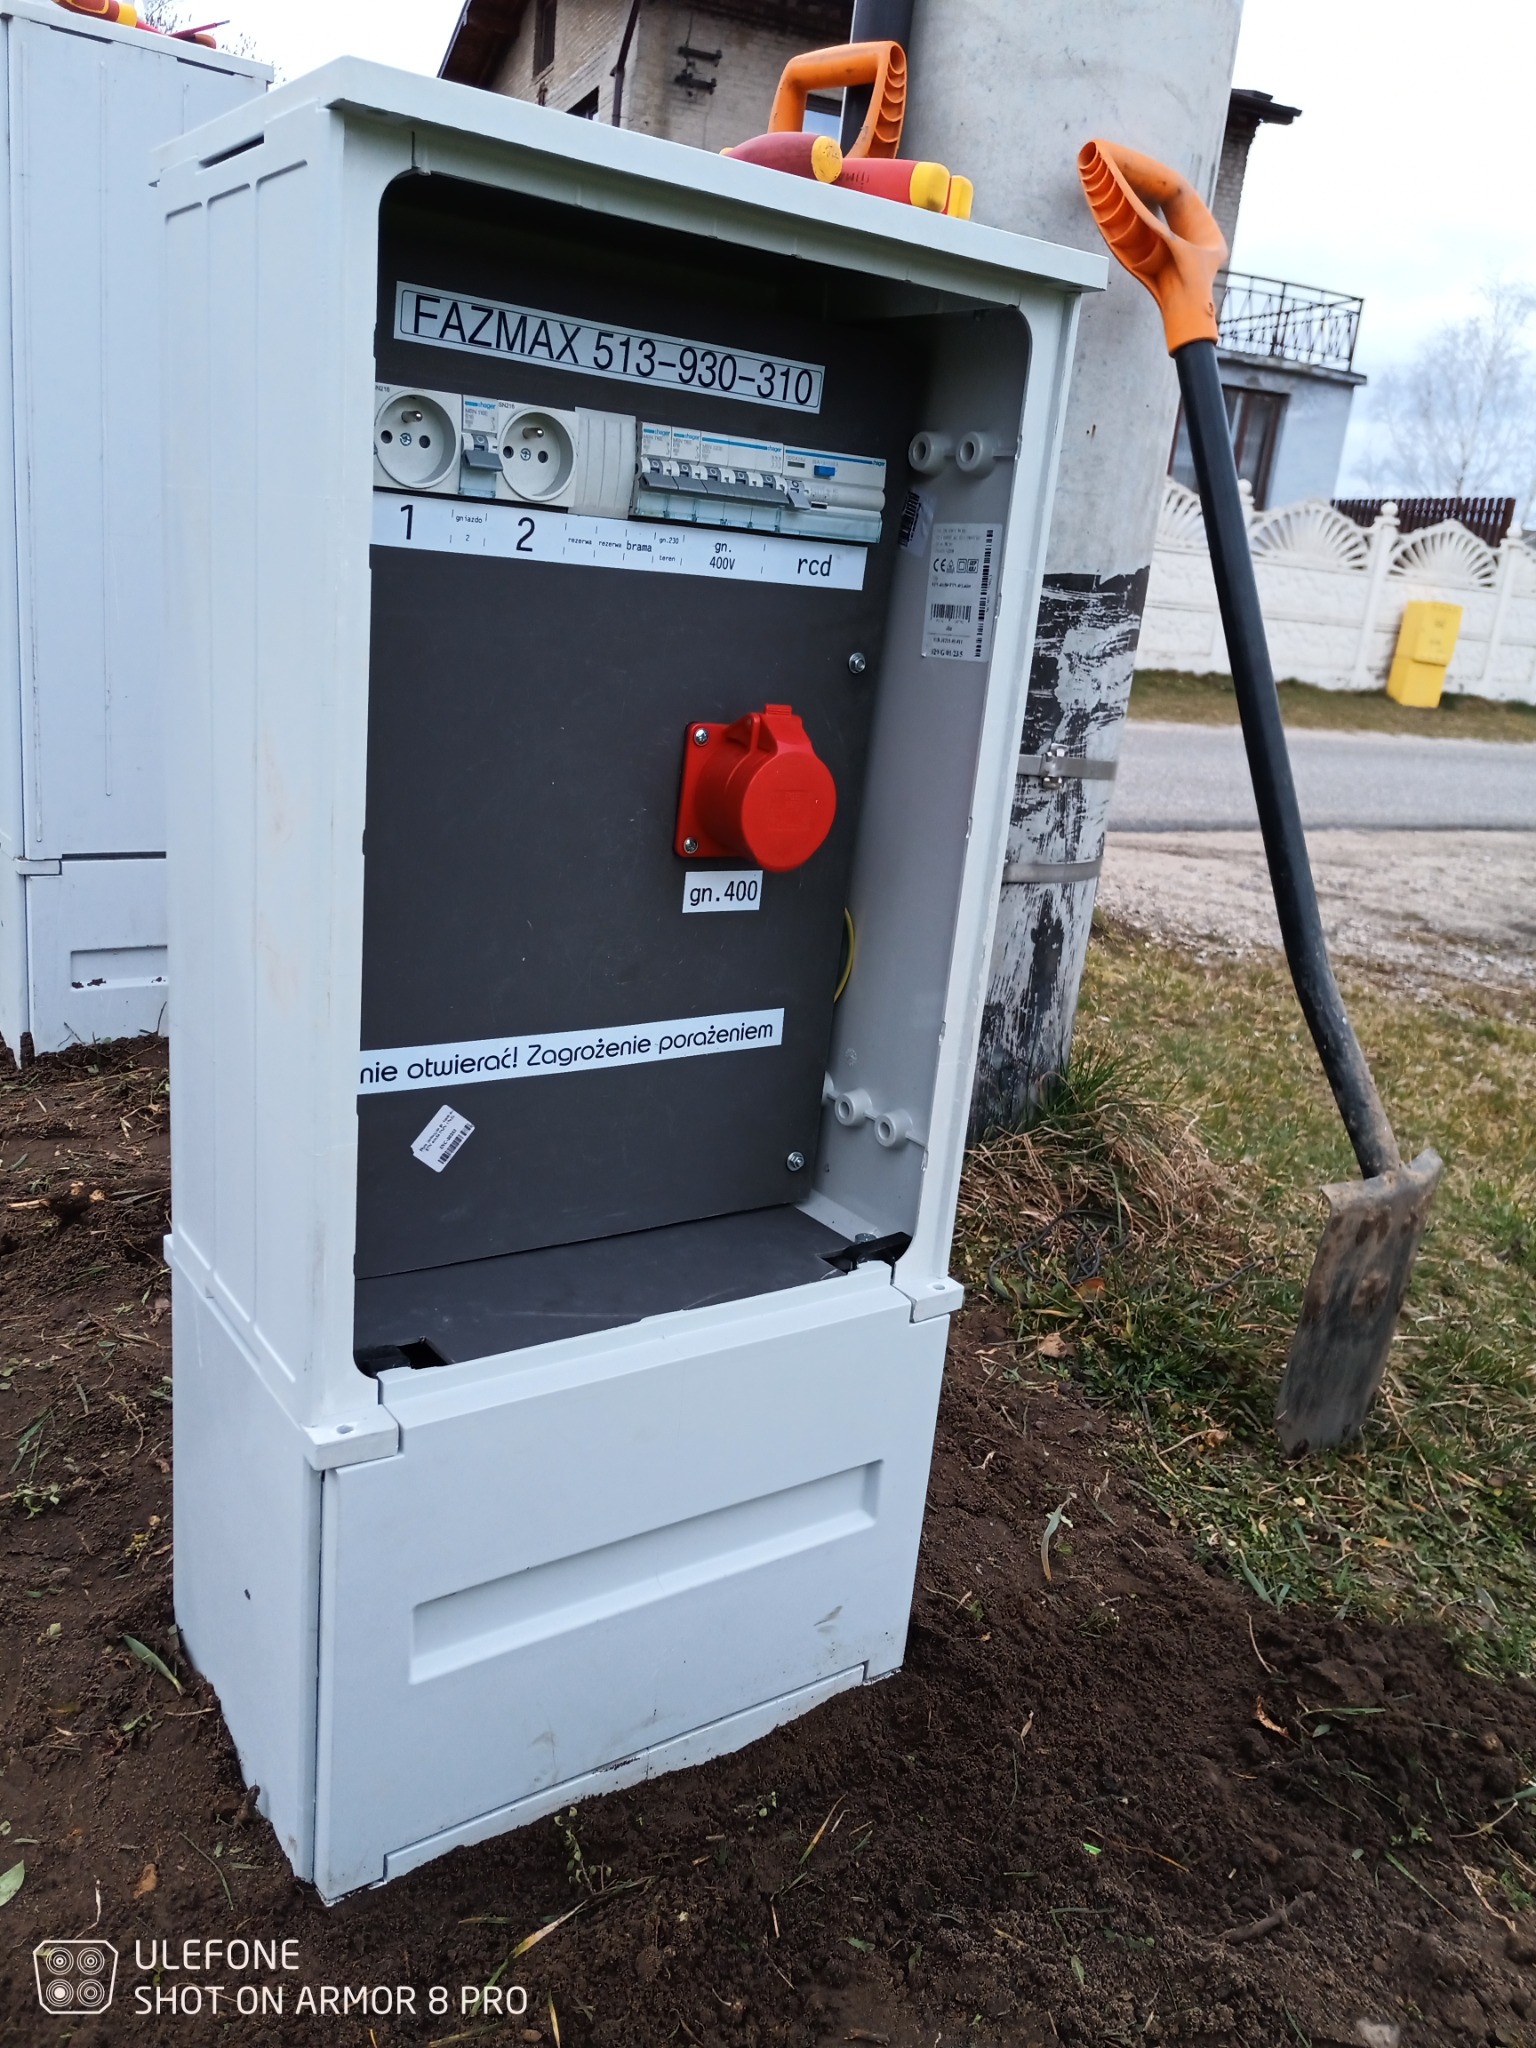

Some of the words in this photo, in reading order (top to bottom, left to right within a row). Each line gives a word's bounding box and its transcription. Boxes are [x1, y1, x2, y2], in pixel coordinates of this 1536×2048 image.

[413, 294, 582, 364] FAZMAX
[593, 331, 813, 405] 513-930-310
[400, 504, 413, 540] 1
[456, 515, 483, 524] gniazdo
[465, 534, 470, 542] 2
[516, 517, 536, 552] 2
[568, 537, 593, 546] rezerwa
[598, 540, 622, 549] rezerwa
[626, 541, 652, 553] brama
[714, 542, 732, 553] gn.
[709, 556, 736, 570] 400V
[797, 554, 832, 577] rcd
[690, 880, 758, 906] gn.400
[360, 1062, 398, 1084] nie
[407, 1046, 518, 1079] otwierać!
[527, 1036, 651, 1066] Zagrożenie
[658, 1022, 773, 1054] porażeniem
